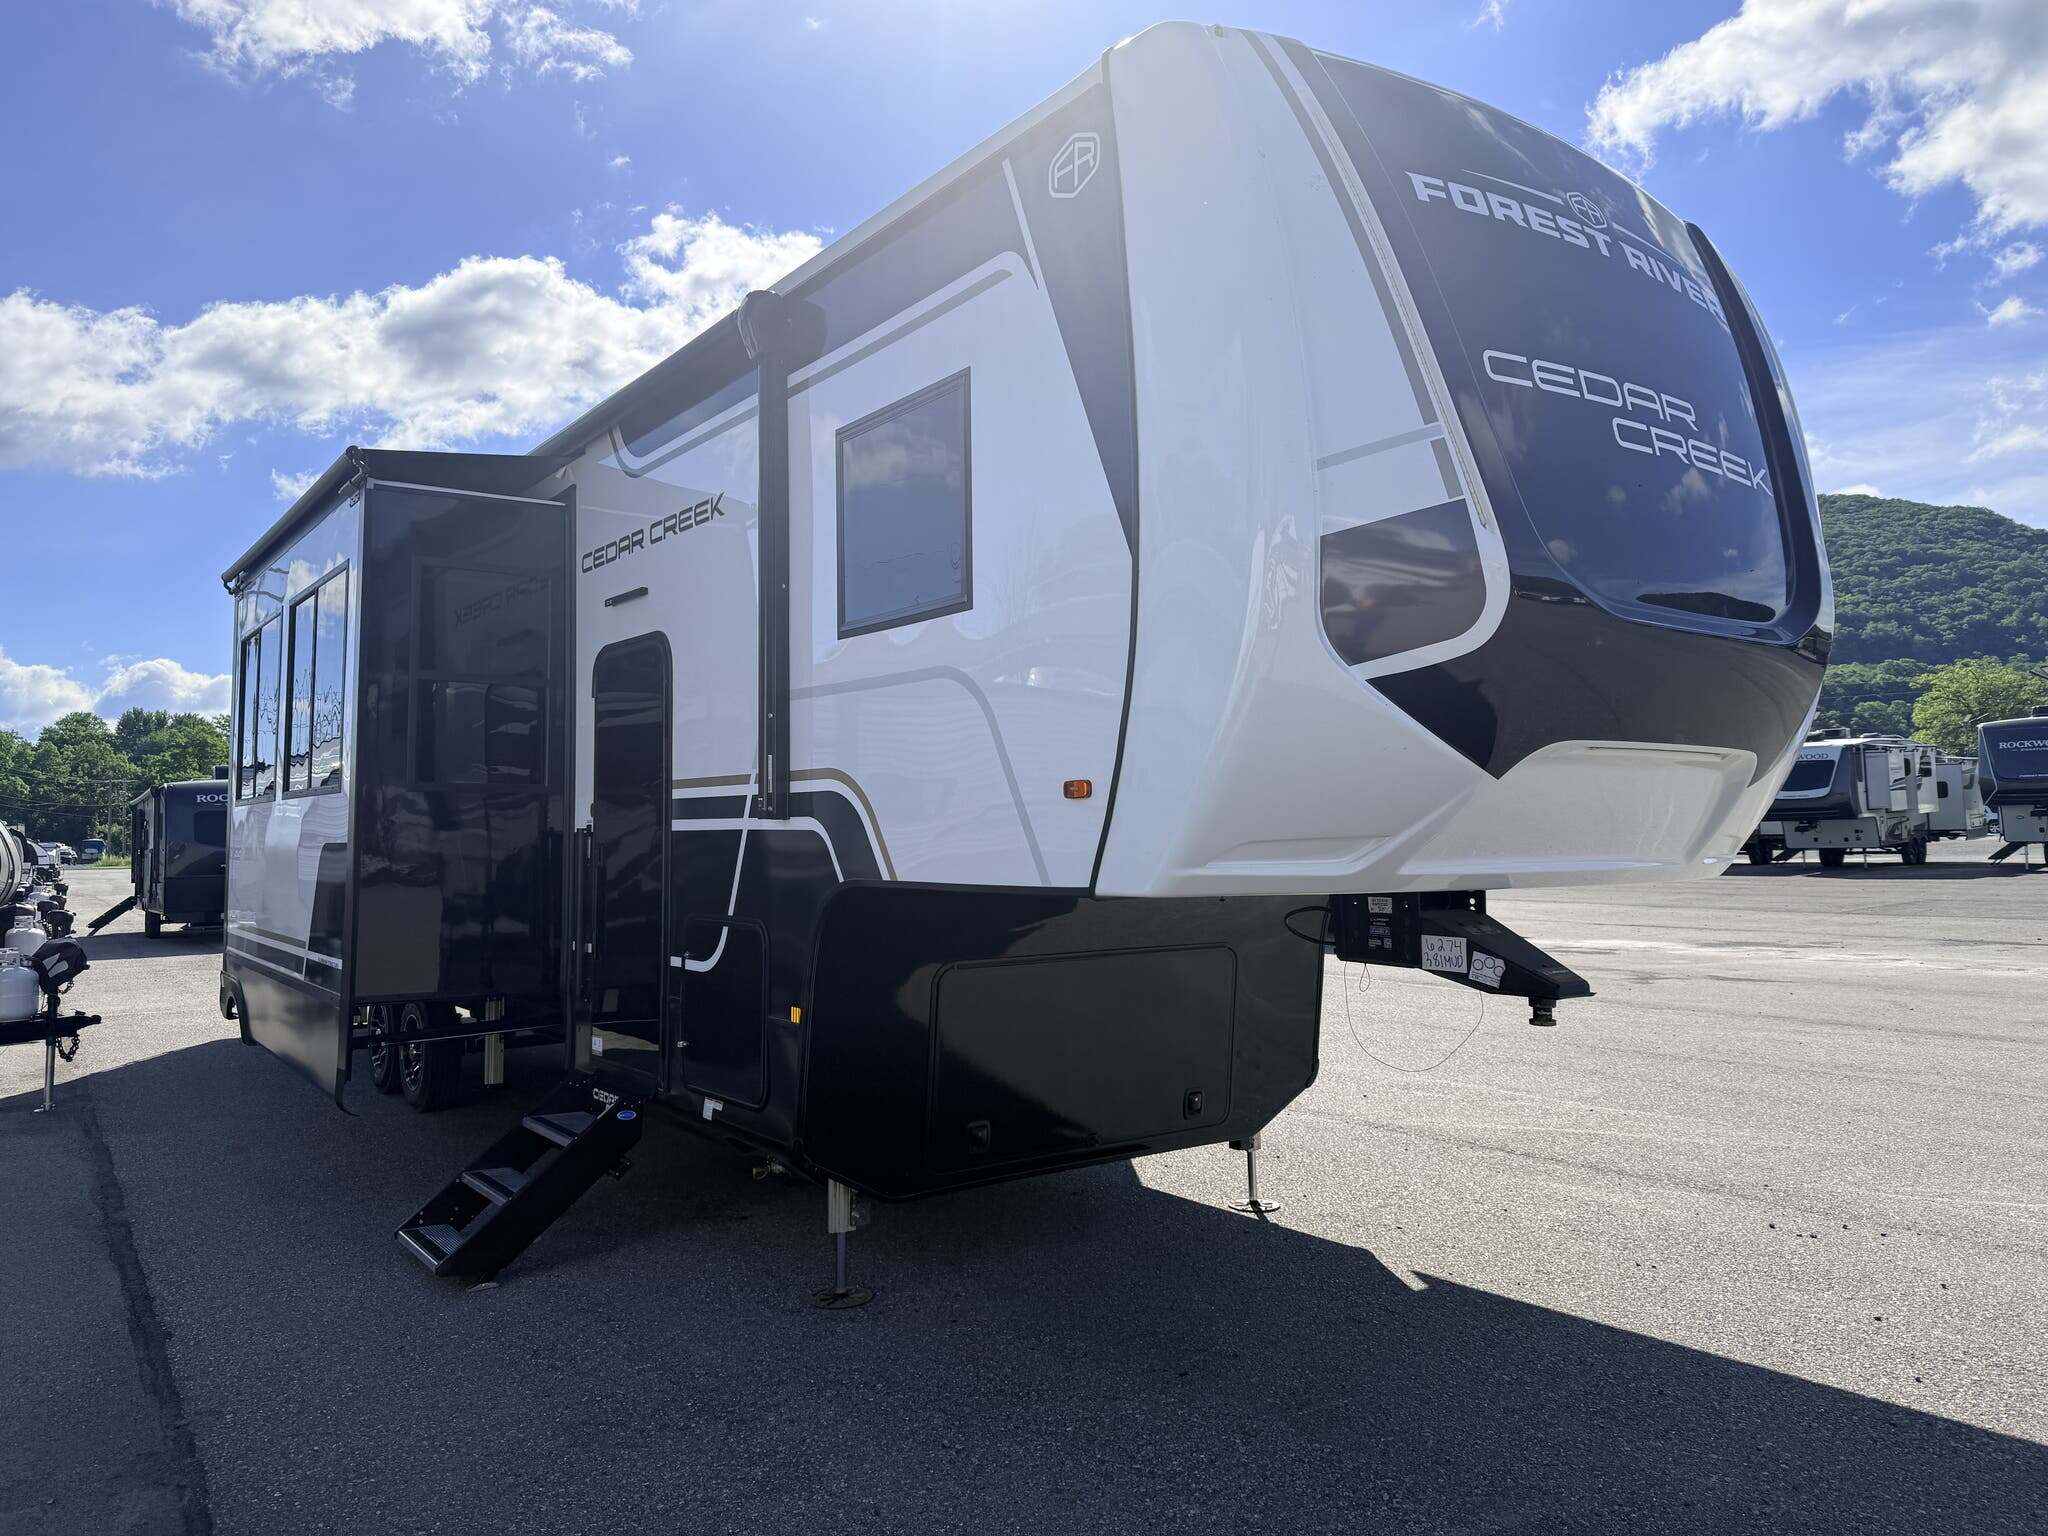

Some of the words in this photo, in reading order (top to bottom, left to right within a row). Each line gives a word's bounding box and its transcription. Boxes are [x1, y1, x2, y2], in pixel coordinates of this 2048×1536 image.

[1404, 171, 1612, 258] FOREST
[1618, 241, 1730, 331] RIVER
[1483, 349, 1699, 431] CEDAR
[1612, 417, 1773, 496] CREEK
[581, 528, 645, 574] CEDAR
[649, 491, 725, 544] CREEK
[1425, 938, 1462, 953] 6274
